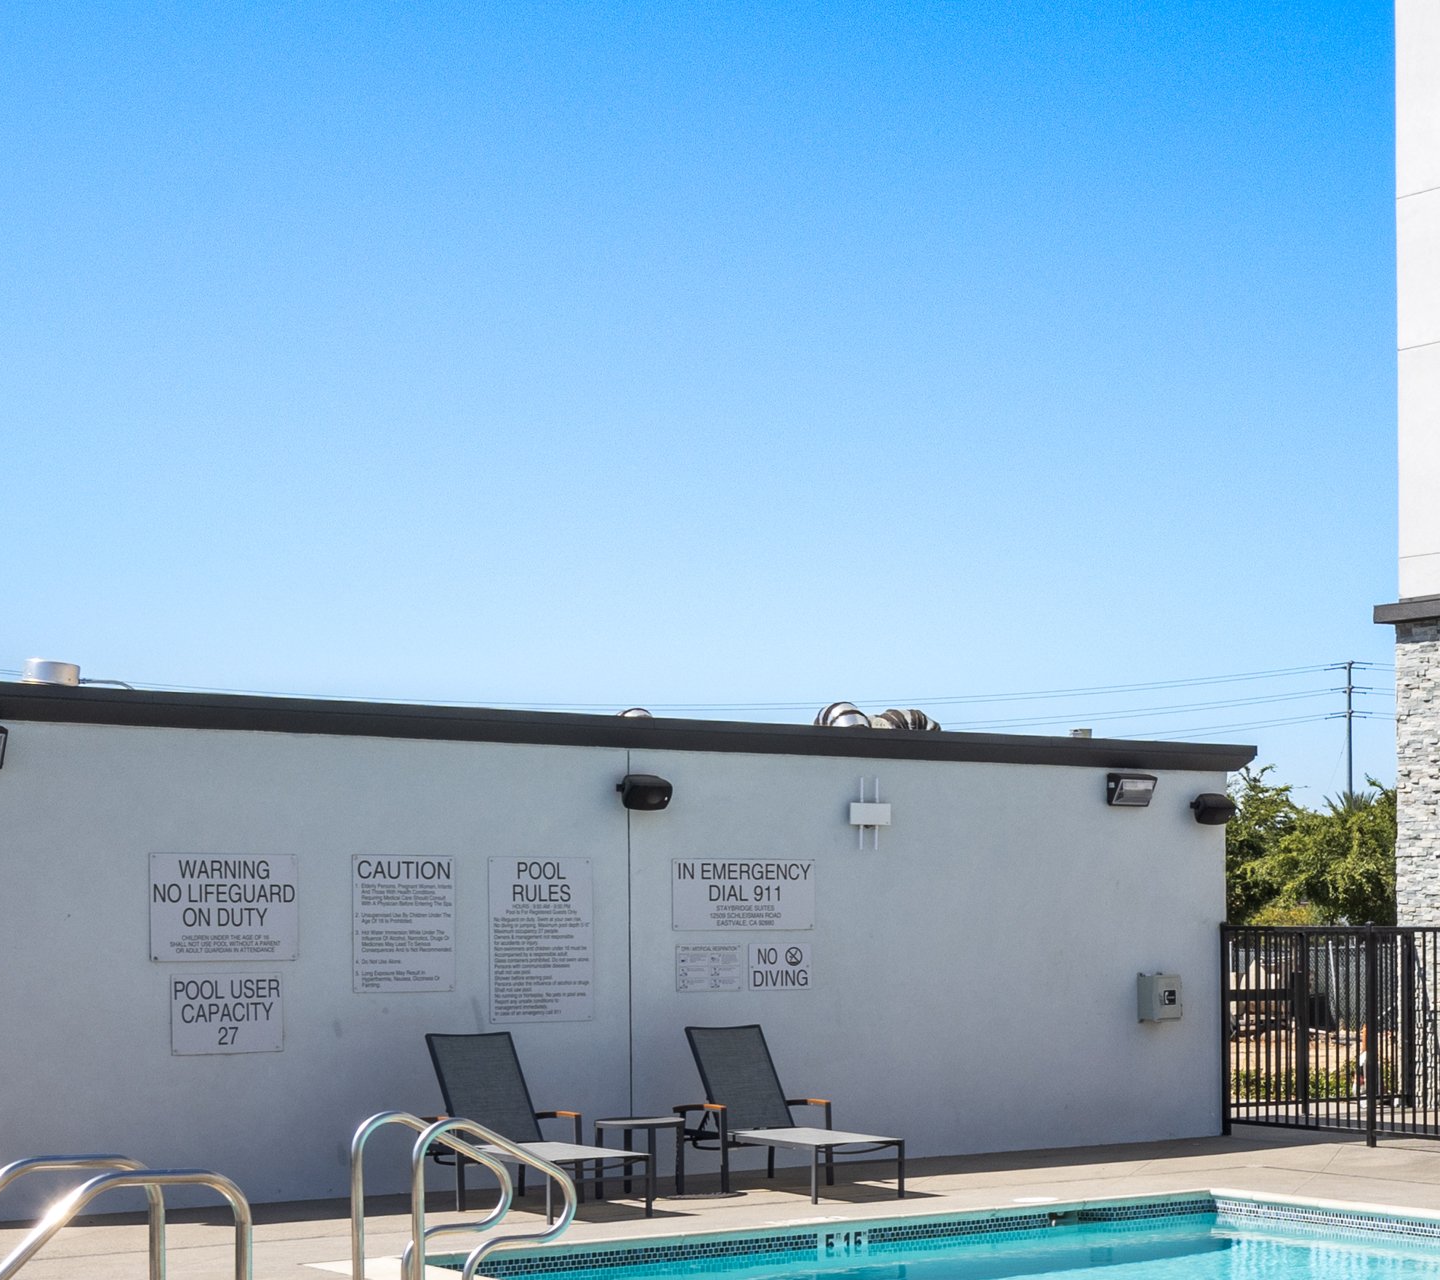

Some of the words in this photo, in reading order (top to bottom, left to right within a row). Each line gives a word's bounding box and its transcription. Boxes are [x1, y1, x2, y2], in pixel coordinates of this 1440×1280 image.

[179, 859, 270, 879] WARNING
[357, 860, 451, 880] CAUTION
[518, 861, 566, 880] POOL
[678, 863, 695, 880] IN
[701, 863, 811, 880] EMERGENCY
[153, 884, 181, 903] NO
[188, 884, 295, 903] LIFEGUARD
[512, 884, 571, 902] RULES
[709, 885, 748, 901] DIAL
[754, 885, 780, 901] 911
[183, 907, 210, 927] ON
[217, 907, 267, 927] DUTY
[758, 948, 778, 965] NO
[754, 970, 808, 987] DIVING
[174, 980, 225, 1000] POOL
[231, 979, 280, 999] USER
[181, 1002, 273, 1023] CAPACITY
[218, 1026, 239, 1045] 27
